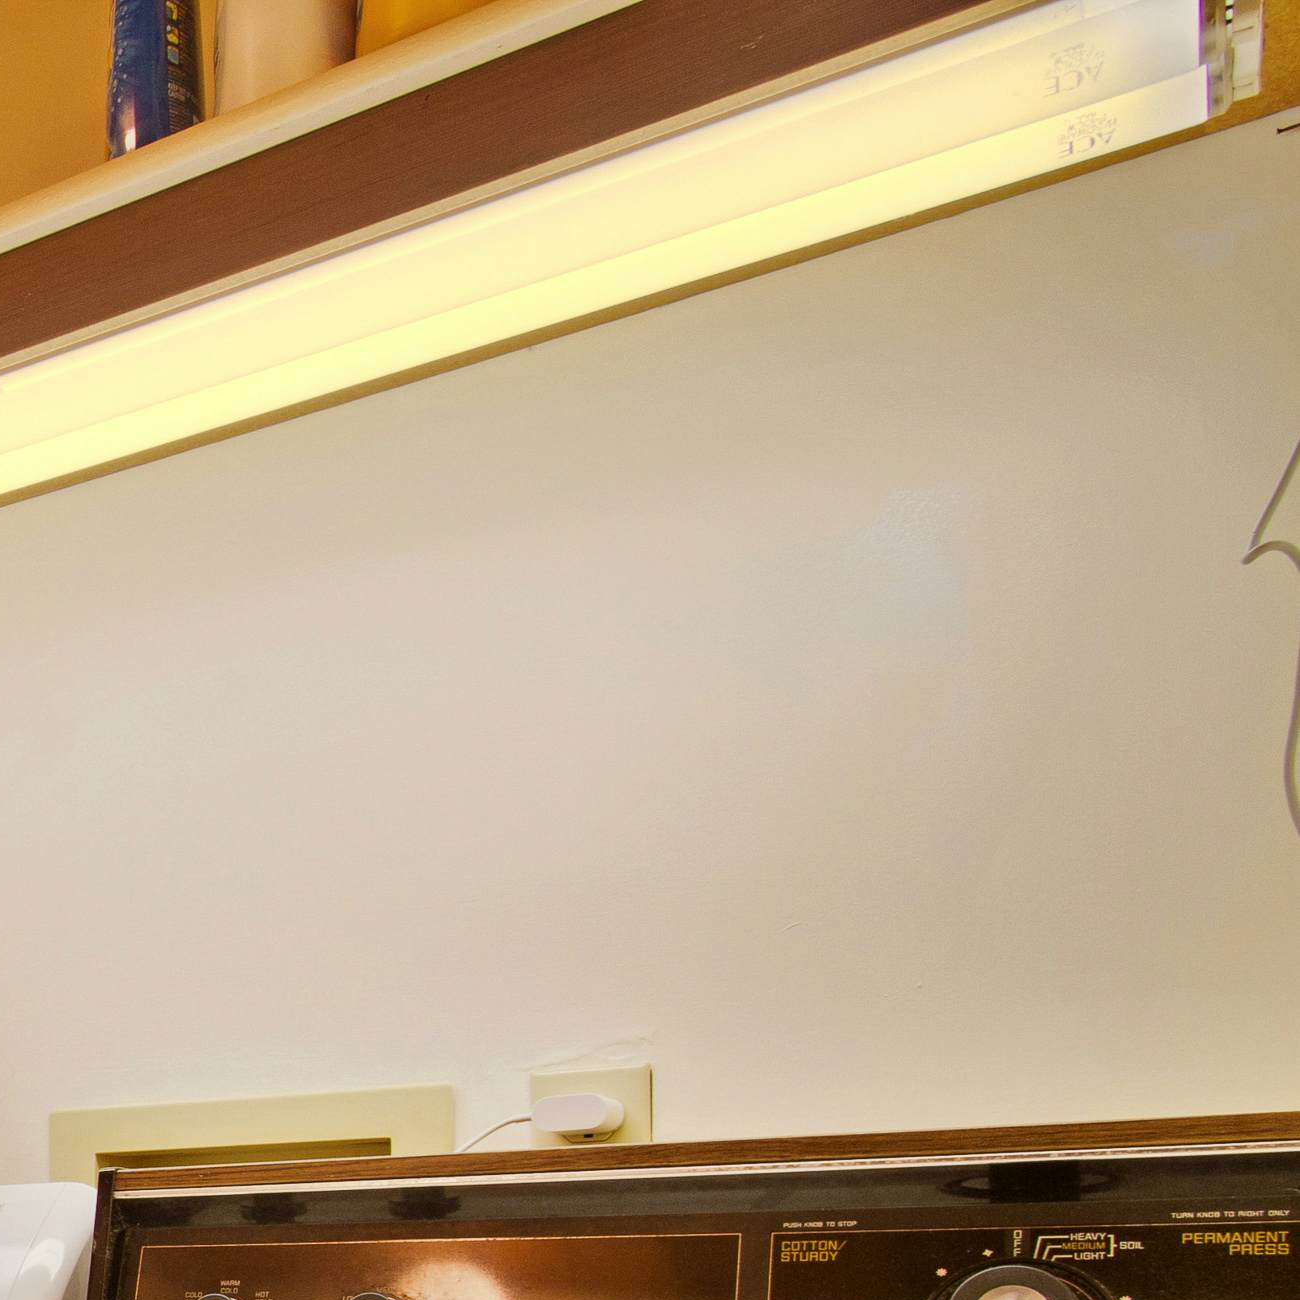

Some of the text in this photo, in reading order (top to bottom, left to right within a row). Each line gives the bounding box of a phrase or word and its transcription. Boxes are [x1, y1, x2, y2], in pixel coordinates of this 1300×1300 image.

[1170, 1211, 1194, 1219] TURN
[1223, 1210, 1236, 1218] TO
[1237, 1210, 1265, 1218] RIGHT
[1267, 1209, 1291, 1217] ONLY
[836, 1220, 859, 1228] STOP
[1069, 1232, 1107, 1241] HEAVY
[1182, 1231, 1289, 1244] PERMANENT
[781, 1240, 847, 1251] COTTON/
[1060, 1241, 1106, 1250] MEDIUM
[1118, 1241, 1145, 1250] SOIL
[1229, 1244, 1290, 1255] PRESS
[781, 1252, 838, 1262] STURDY
[1073, 1251, 1107, 1261] LIGHT
[220, 1279, 241, 1287] WARM
[254, 1291, 270, 1299] HOT
